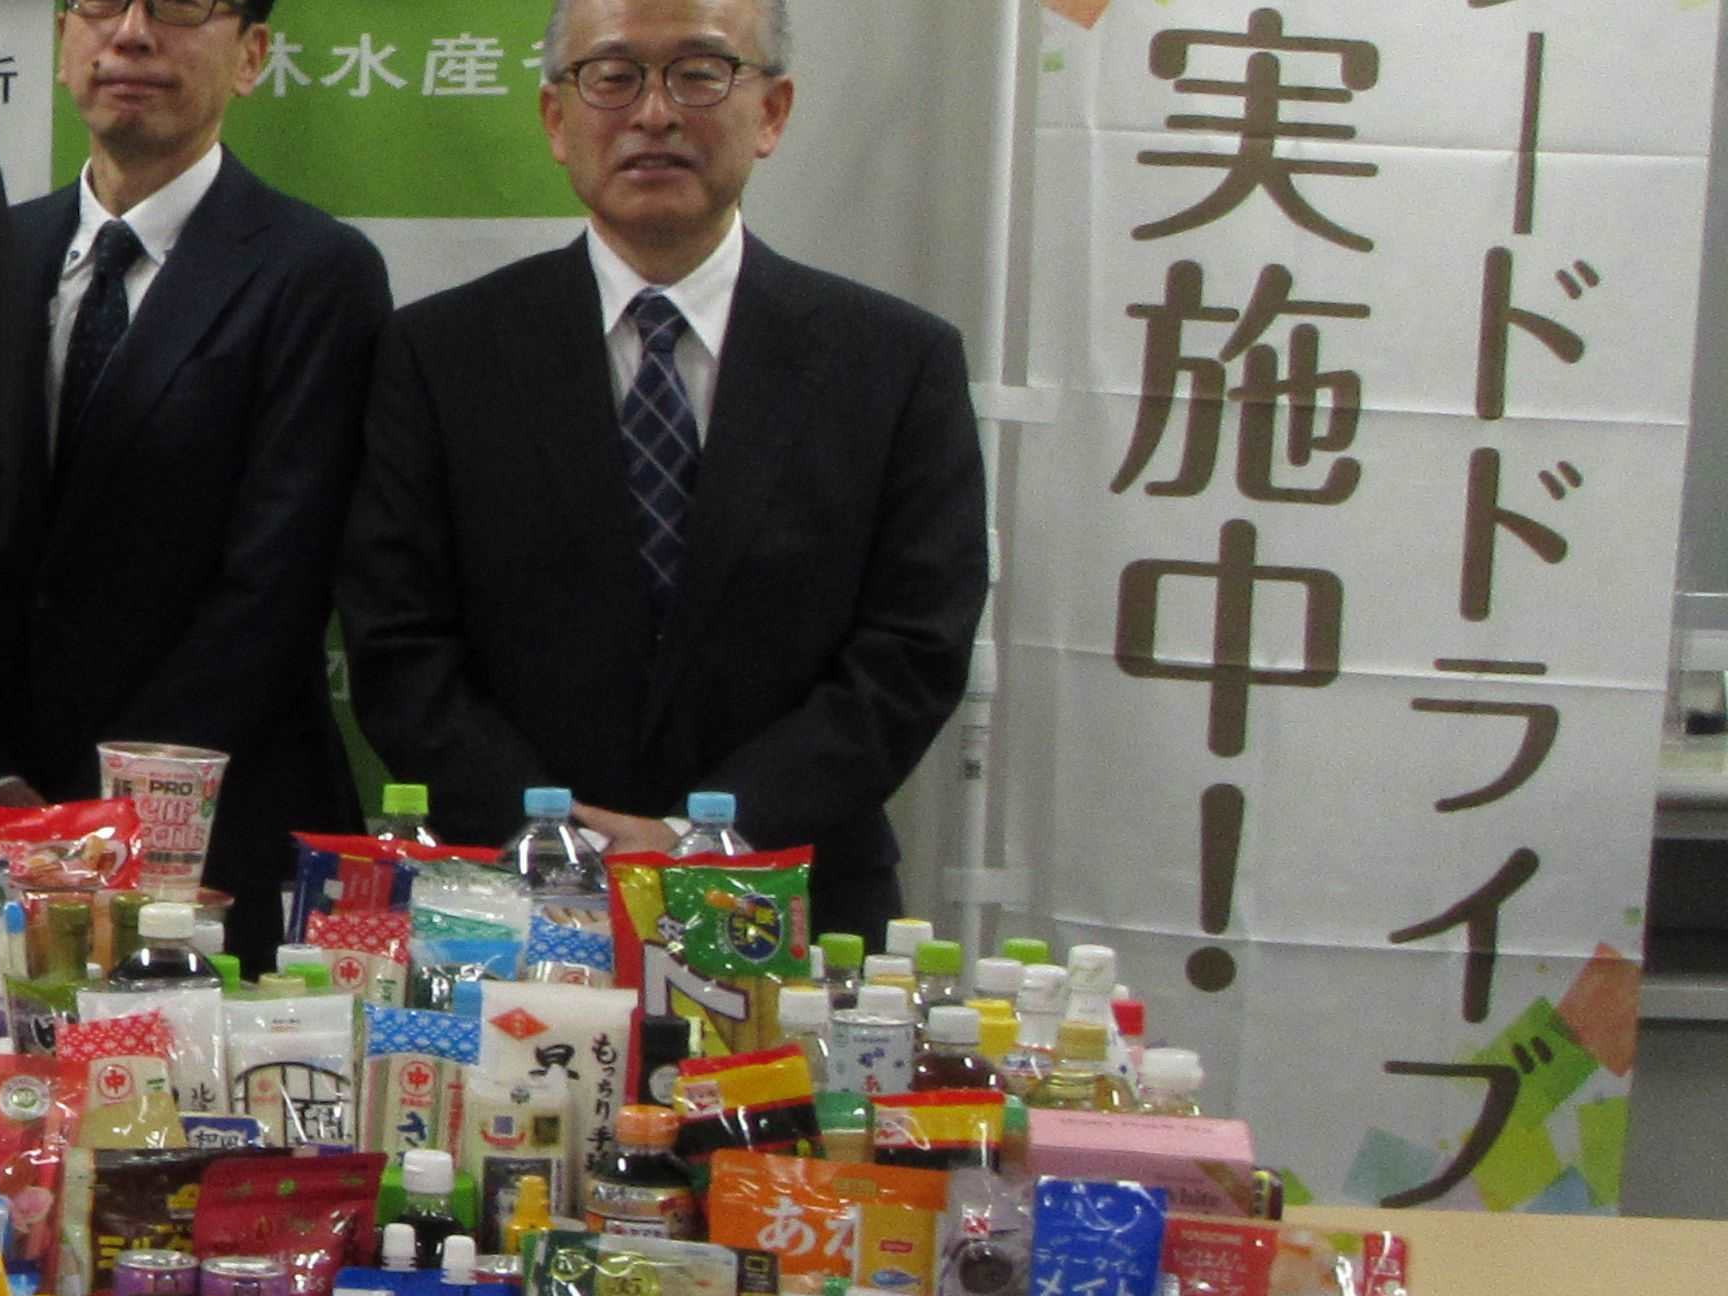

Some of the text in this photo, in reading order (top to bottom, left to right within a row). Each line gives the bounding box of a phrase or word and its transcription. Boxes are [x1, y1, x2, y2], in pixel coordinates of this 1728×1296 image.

[1110, 6, 1382, 993] 実施中!
[148, 779, 194, 797] PRO
